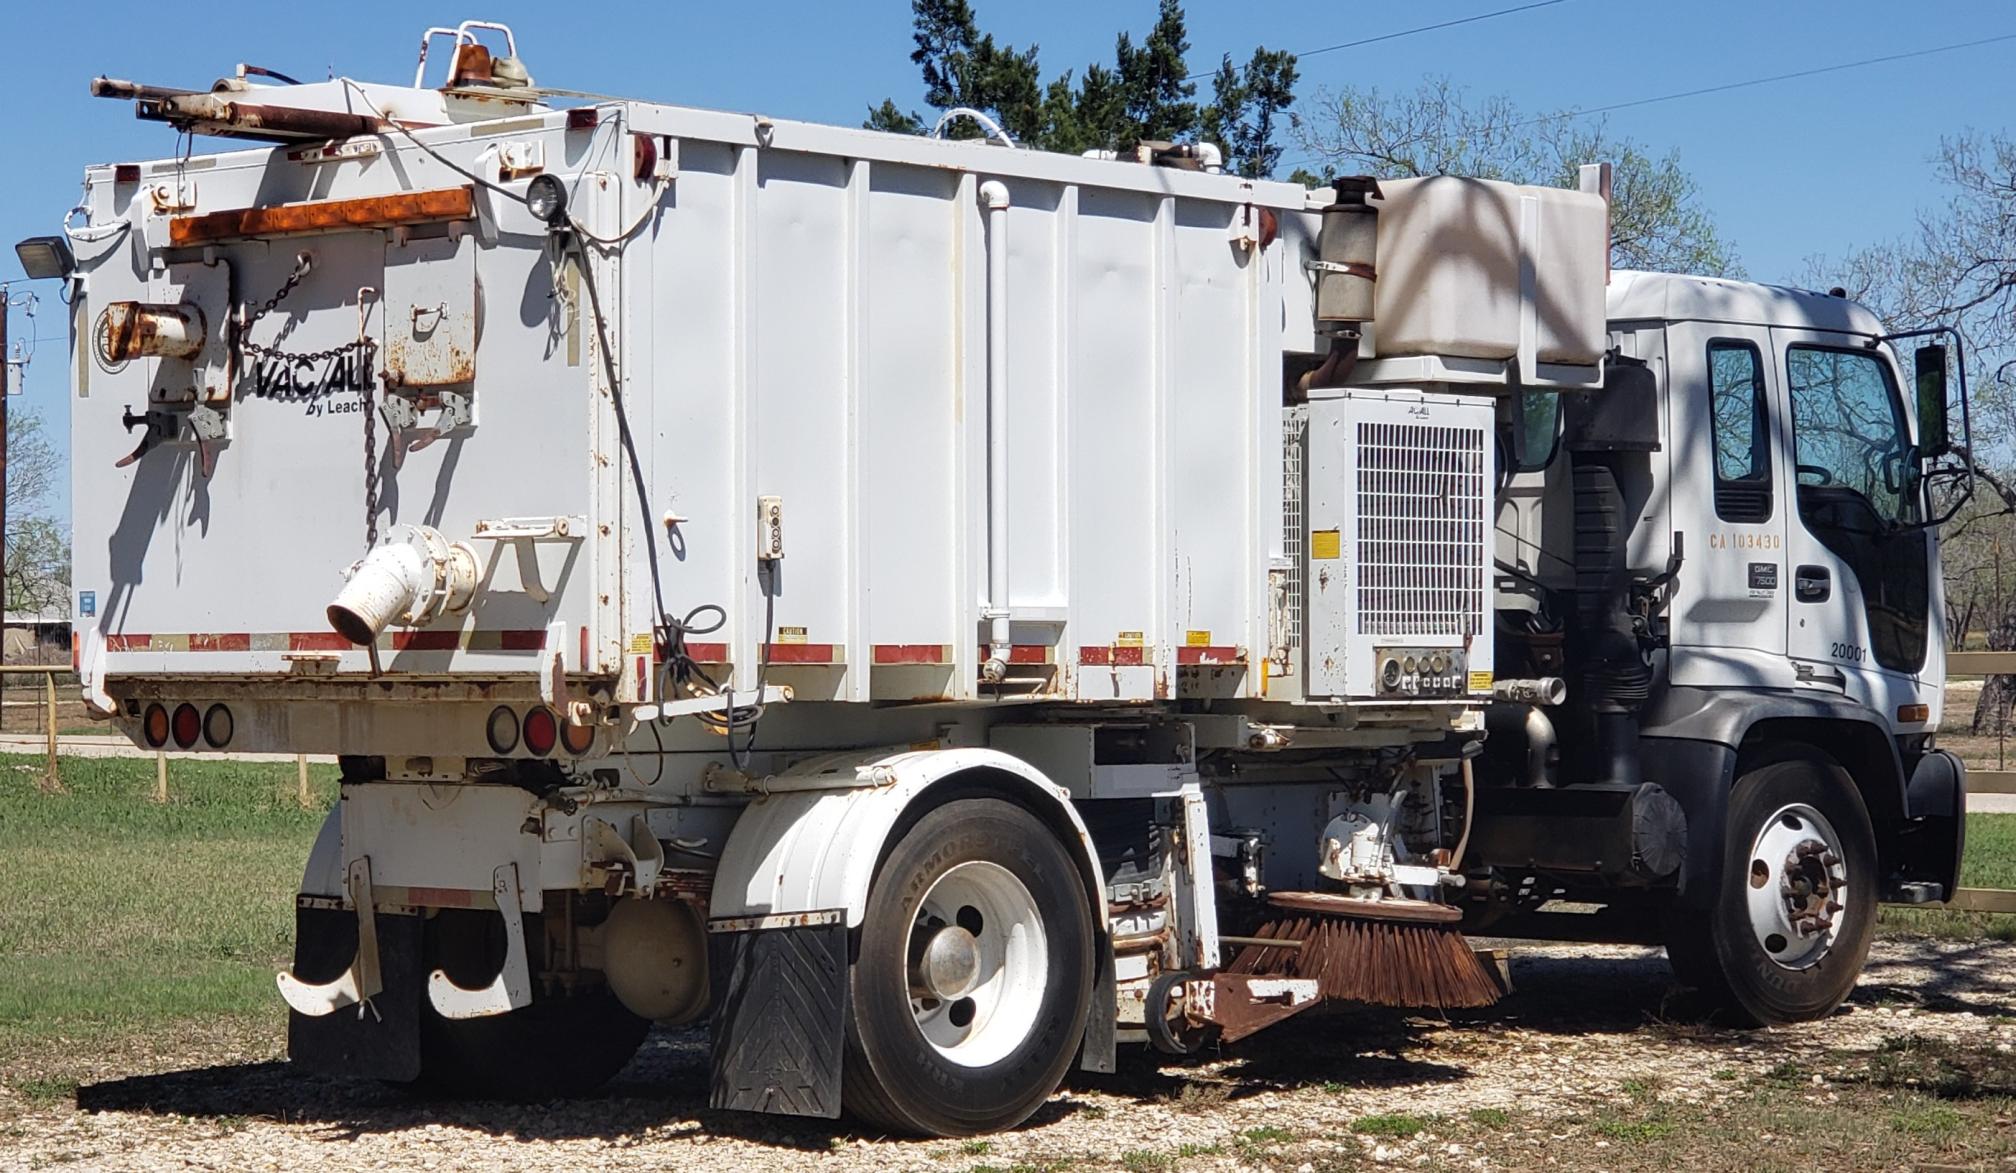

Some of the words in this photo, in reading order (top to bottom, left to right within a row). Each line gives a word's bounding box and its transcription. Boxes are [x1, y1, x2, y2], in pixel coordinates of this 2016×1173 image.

[305, 401, 324, 417] by
[328, 397, 367, 415] Leach
[1710, 534, 1726, 549] CA
[1732, 533, 1780, 549] 103430
[1754, 564, 1774, 574] GMC
[1831, 642, 1867, 662] 20001
